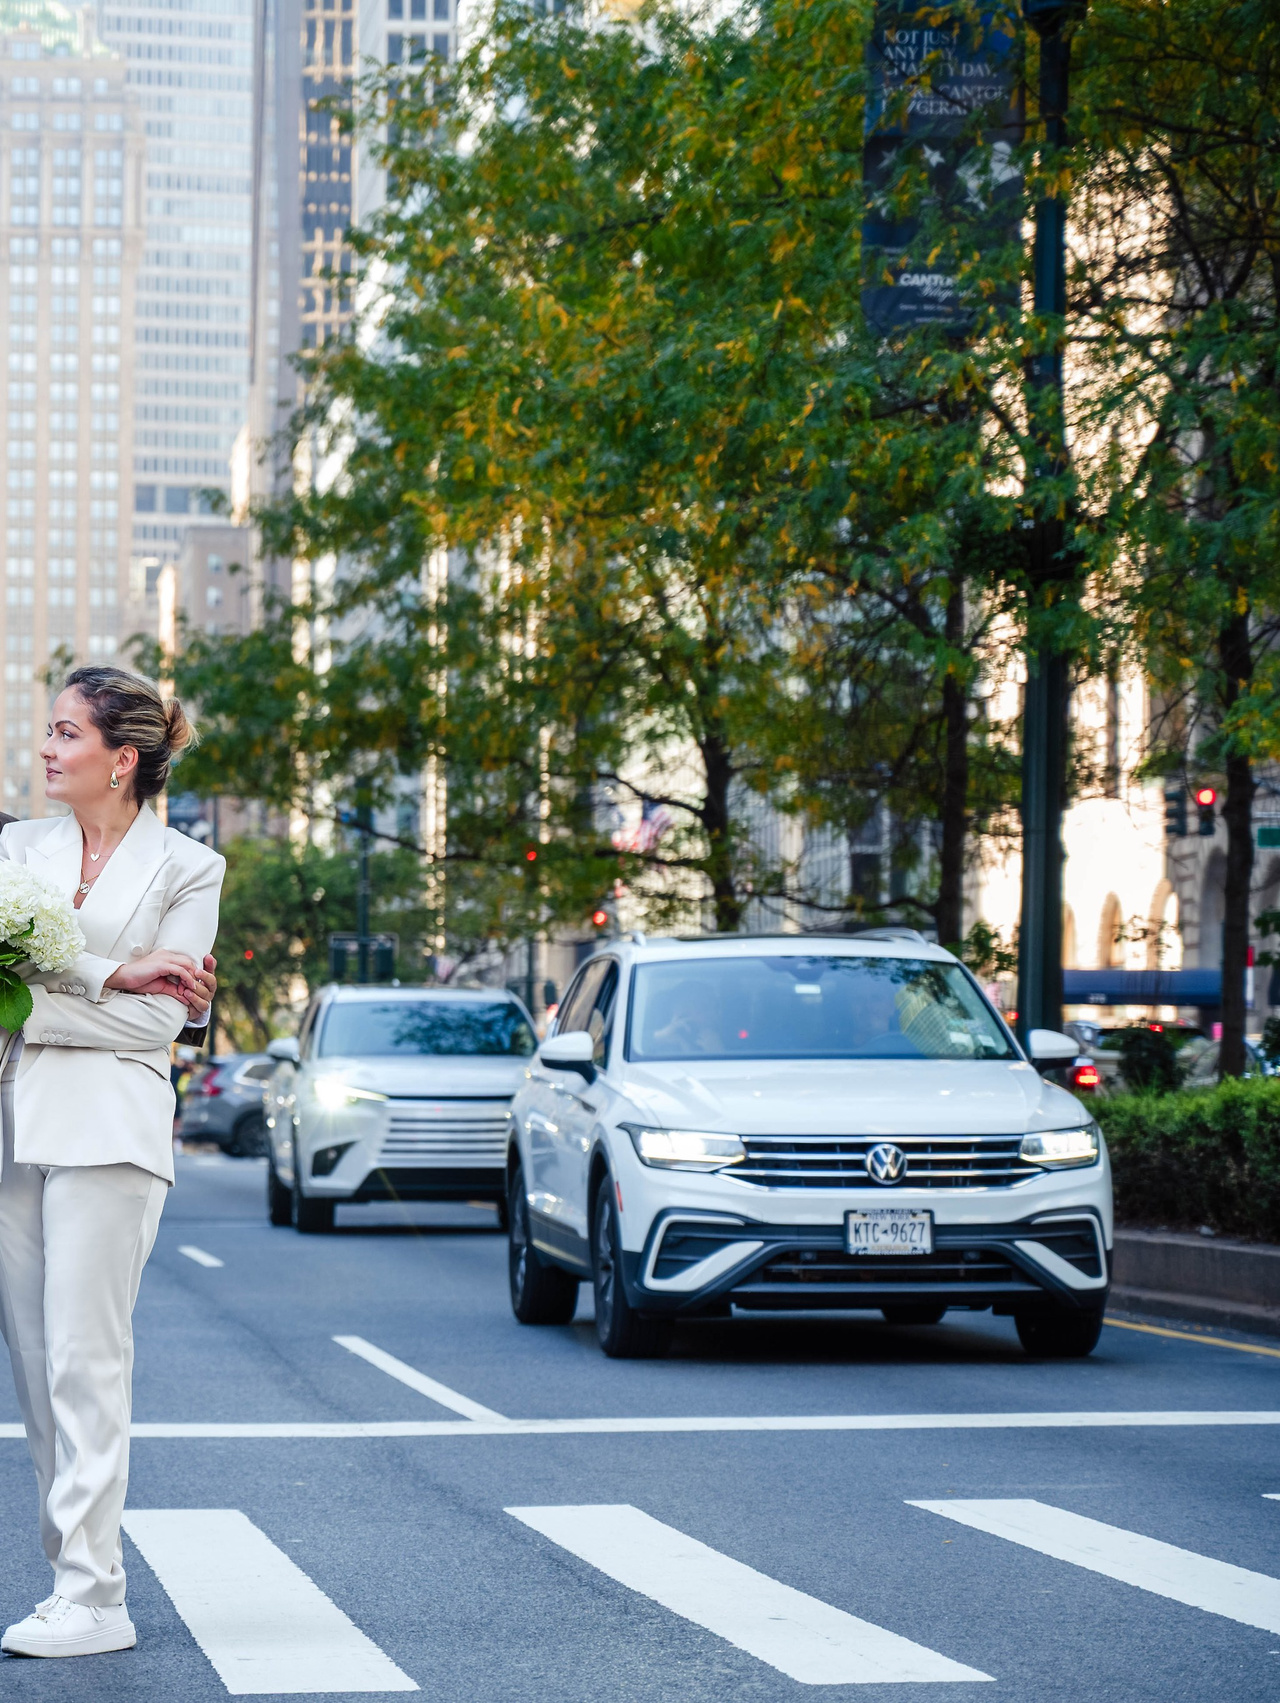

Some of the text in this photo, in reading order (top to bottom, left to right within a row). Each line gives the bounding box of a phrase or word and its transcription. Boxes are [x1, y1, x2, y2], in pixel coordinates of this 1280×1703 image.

[883, 30, 958, 48] NOT JUST
[884, 46, 919, 60] ANY
